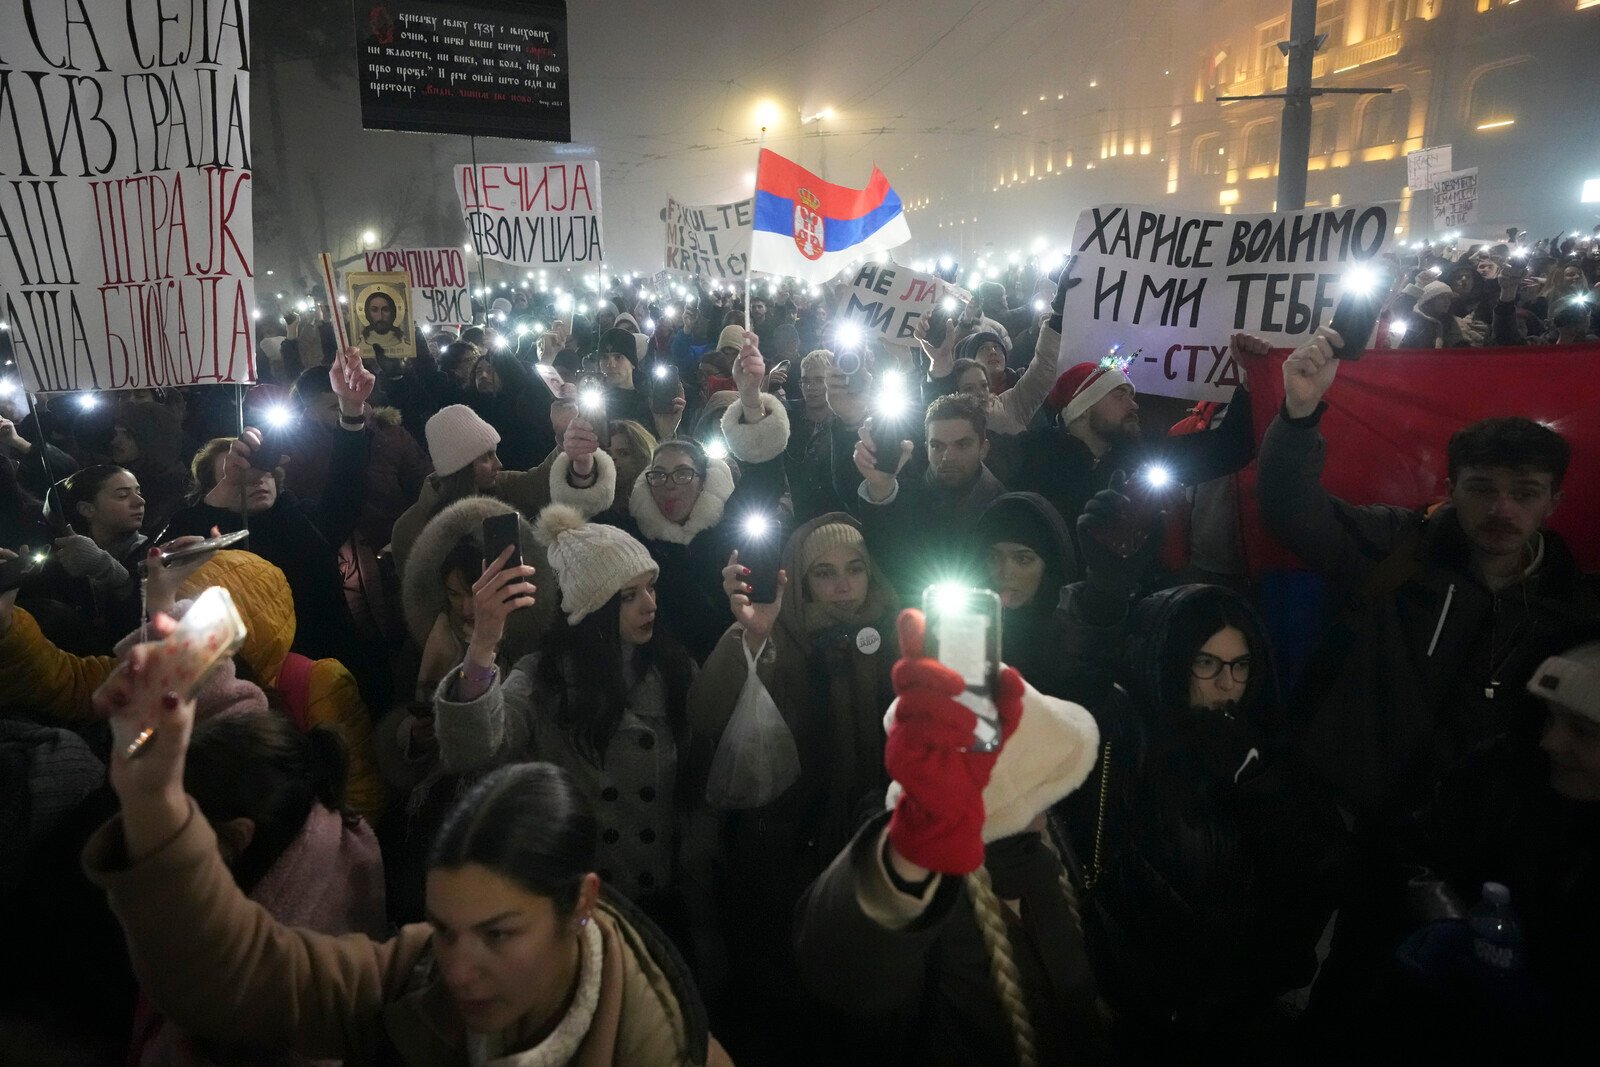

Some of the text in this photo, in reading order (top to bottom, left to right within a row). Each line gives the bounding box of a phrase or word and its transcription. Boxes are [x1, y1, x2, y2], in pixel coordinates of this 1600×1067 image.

[22, 0, 250, 72] СА СЕЛА
[21, 71, 117, 177] ИЗ
[121, 68, 252, 175] ГРАДА
[463, 164, 592, 212] ДЕЧИЈА
[88, 166, 254, 286] ШТРАЈК
[465, 211, 602, 264] ЕВОЛУЦИЈА
[1079, 206, 1387, 269] ХАРИСЕ ВОЛИМО
[422, 288, 472, 323] УВИС
[853, 265, 896, 296] НЕ
[899, 278, 947, 304] ЛА
[1093, 266, 1128, 322] И
[1132, 273, 1207, 328] МИ
[97, 276, 257, 390] БЛОКАДА
